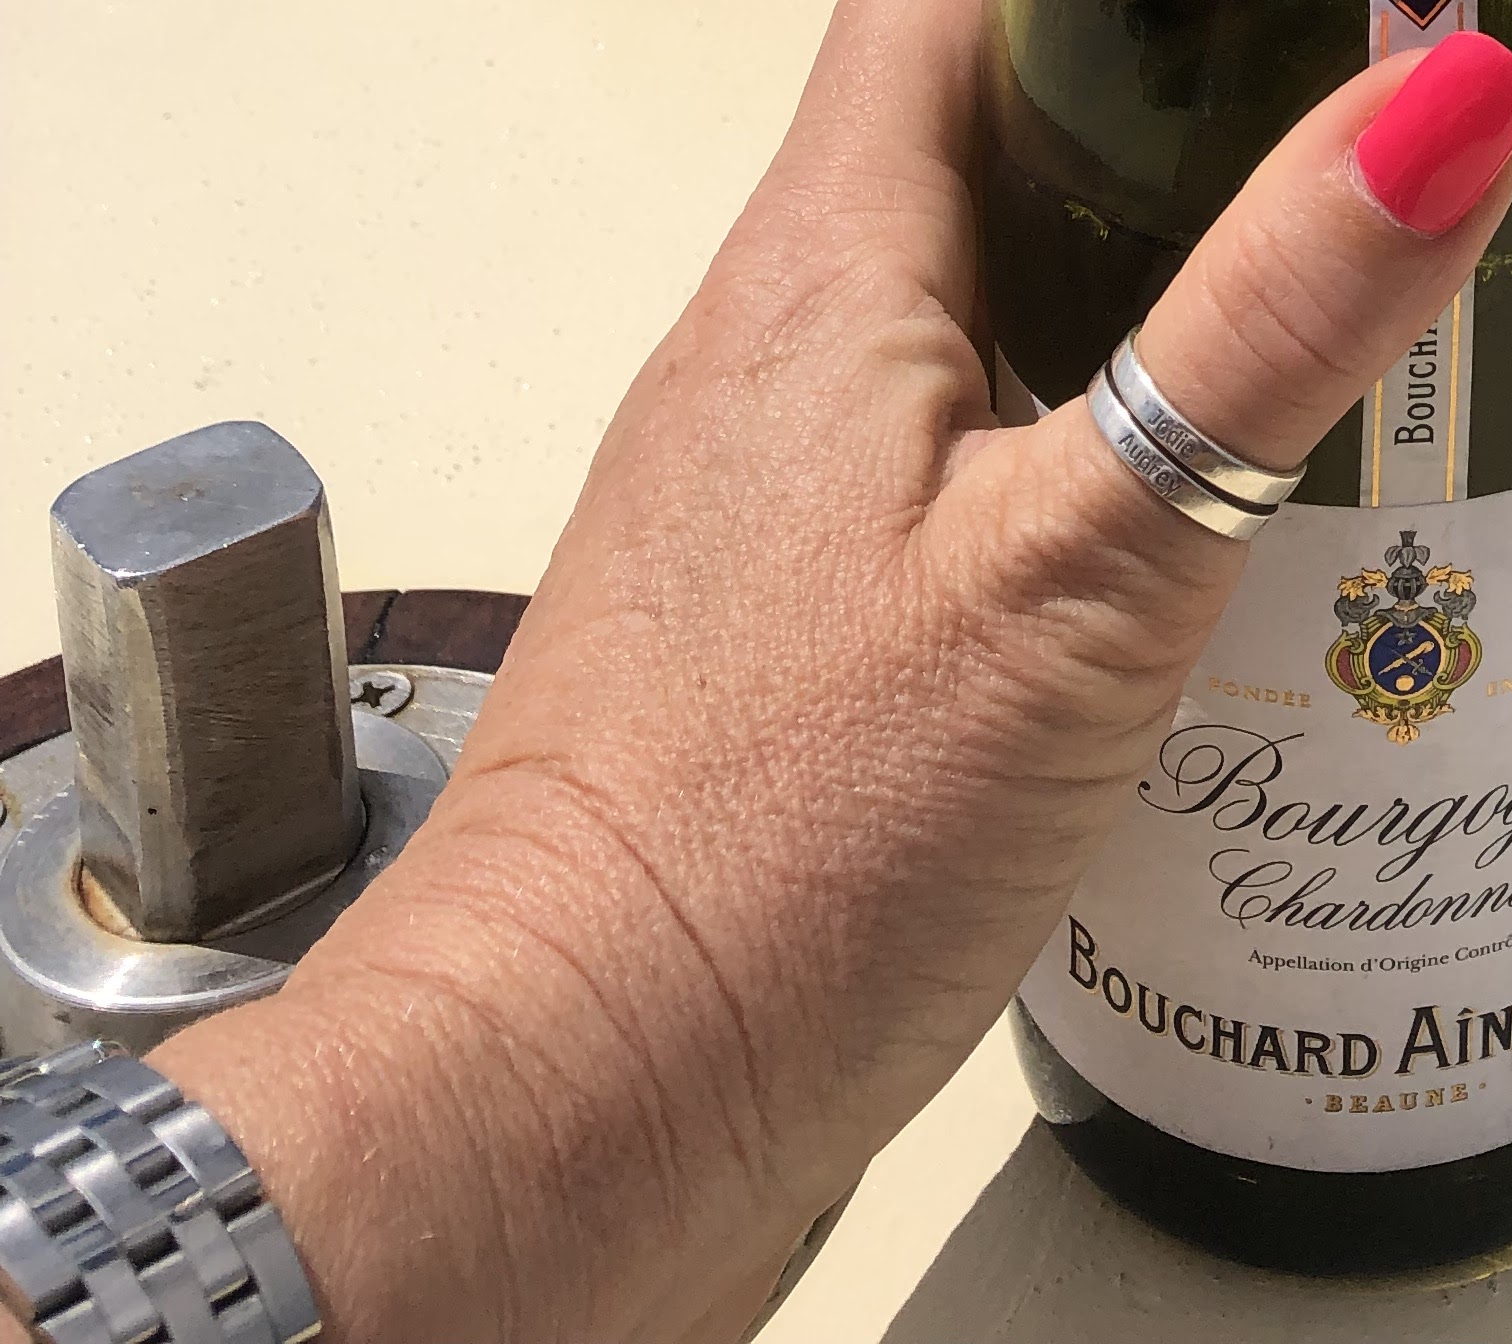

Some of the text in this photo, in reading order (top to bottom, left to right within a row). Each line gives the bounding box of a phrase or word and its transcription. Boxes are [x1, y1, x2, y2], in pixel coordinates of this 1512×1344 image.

[1393, 320, 1438, 446] BOUCH
[1117, 432, 1182, 497] Audrey
[1247, 949, 1354, 973] Appellation
[1360, 952, 1450, 974] d'Origine
[1068, 914, 1383, 1080] BOUCHARD
[1323, 1083, 1469, 1114] BEAUNE
